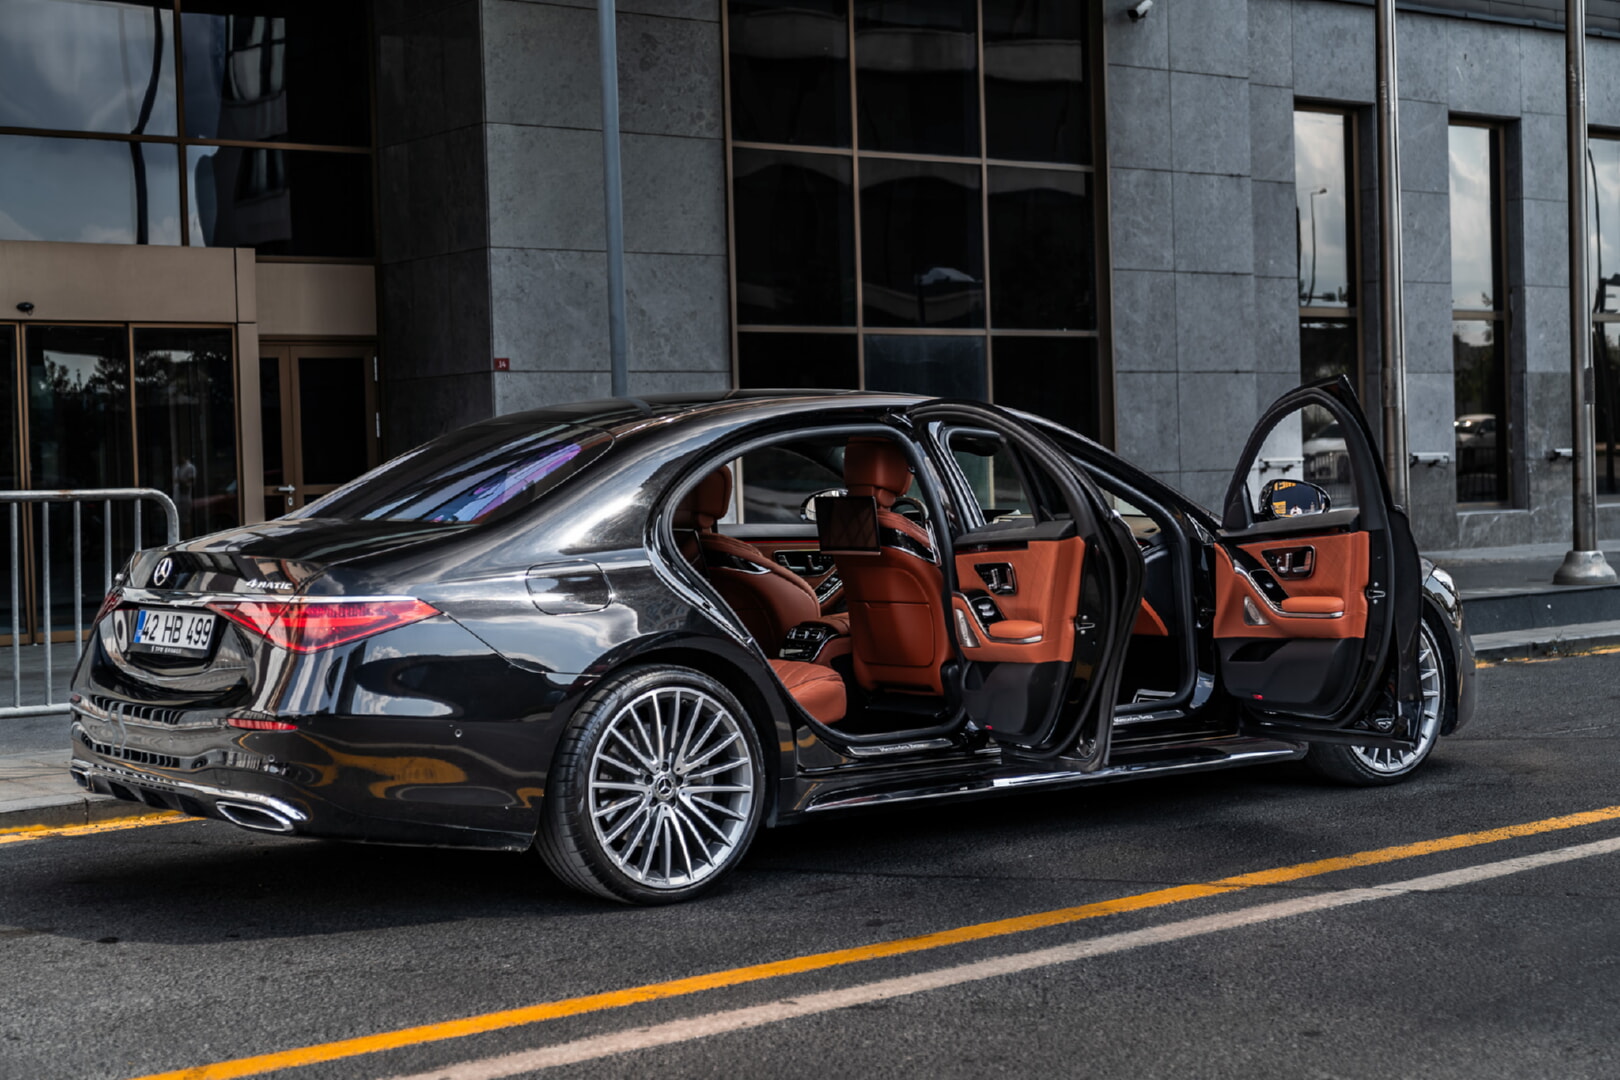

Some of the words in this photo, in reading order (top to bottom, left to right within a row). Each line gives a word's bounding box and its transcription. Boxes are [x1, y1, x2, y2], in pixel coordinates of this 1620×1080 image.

[245, 578, 293, 590] 4MATIC
[142, 613, 160, 641] 42
[161, 614, 184, 643] HB
[186, 616, 212, 646] 499
